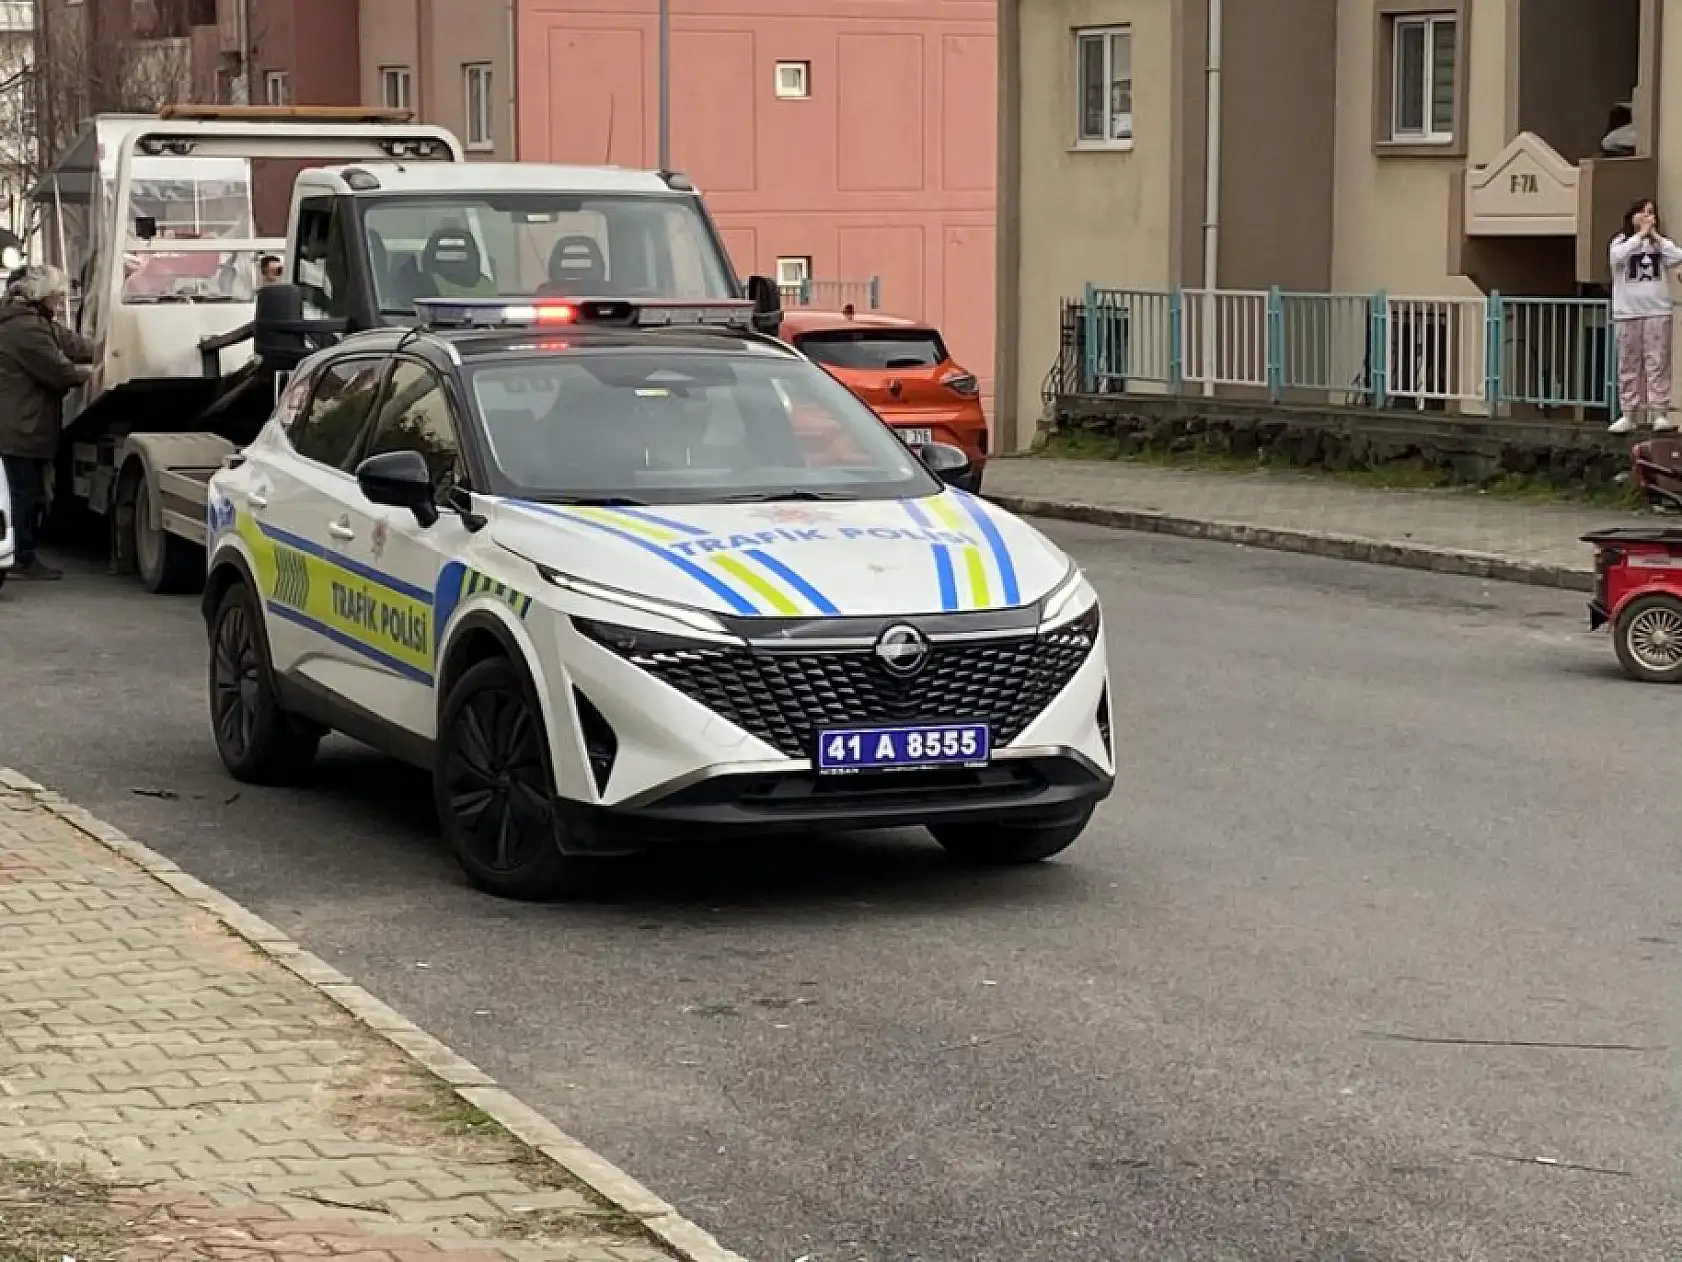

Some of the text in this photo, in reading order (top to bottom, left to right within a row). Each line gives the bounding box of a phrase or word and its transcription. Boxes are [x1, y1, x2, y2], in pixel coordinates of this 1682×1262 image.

[1510, 174, 1539, 194] F-7A
[670, 527, 829, 556] TRAFİK
[331, 580, 428, 655] TRAFİK POLİSİ
[827, 730, 977, 761] 41 A 8555
